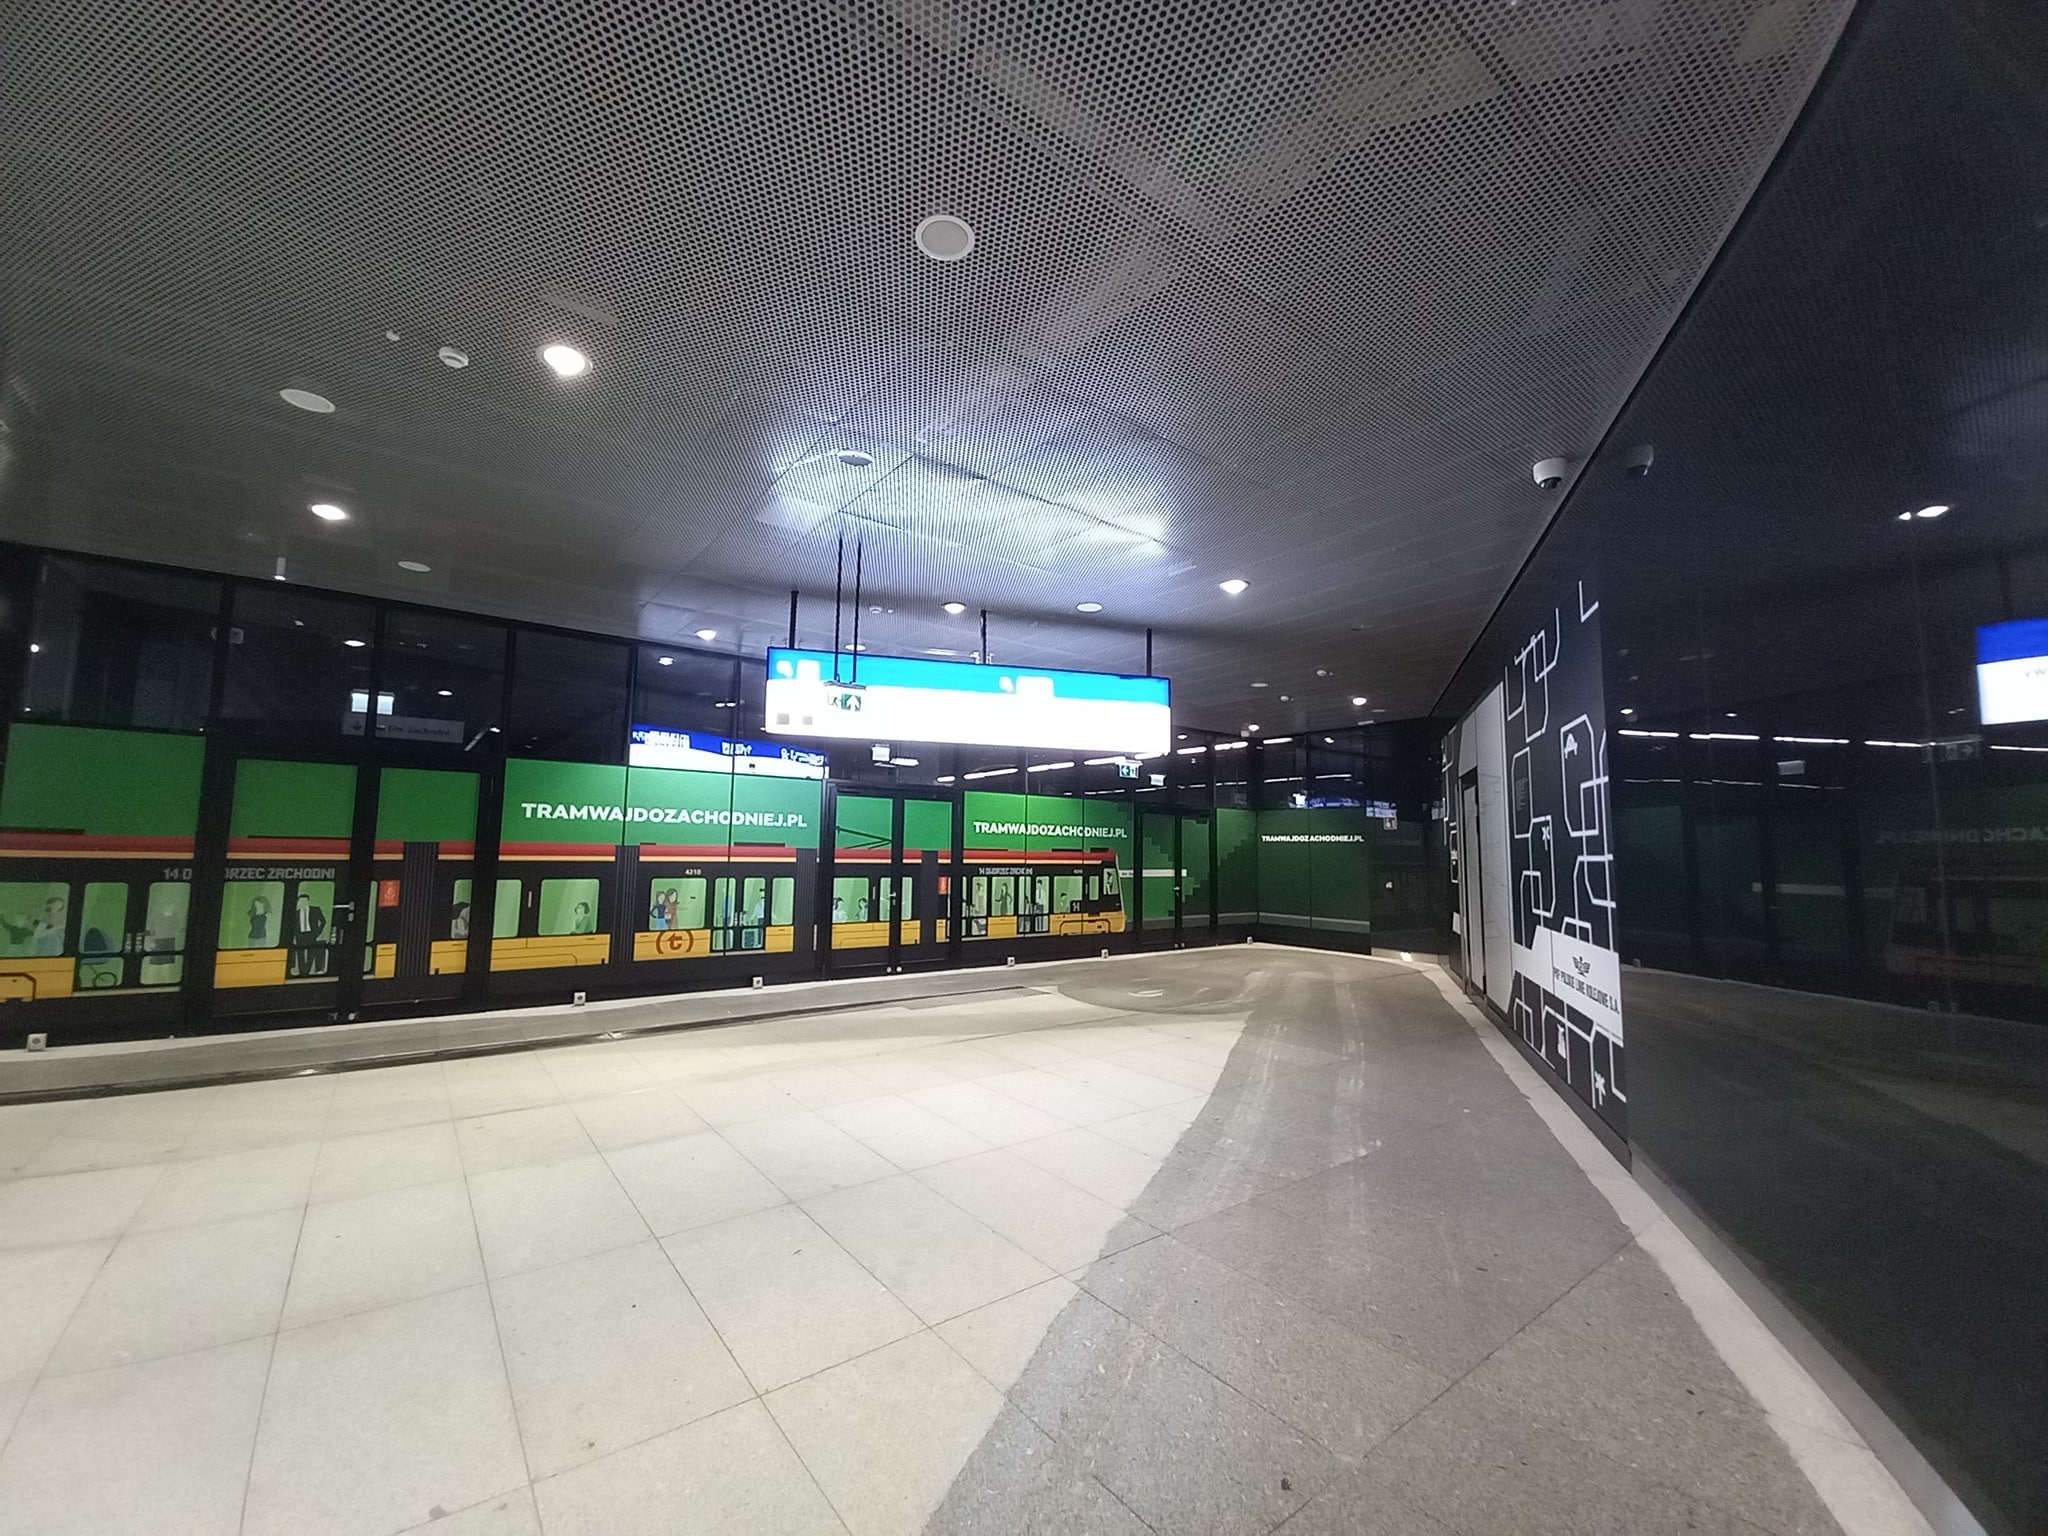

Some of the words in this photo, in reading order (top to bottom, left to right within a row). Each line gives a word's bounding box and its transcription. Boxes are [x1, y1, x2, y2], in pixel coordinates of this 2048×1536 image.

[521, 803, 807, 828] TRAMWAJDOZACHODNIEJ.PL
[973, 821, 1127, 838] TRAMWAJDOZACHODNIEJ.PL
[163, 868, 179, 880] 14
[268, 868, 336, 879] ZACHODNI
